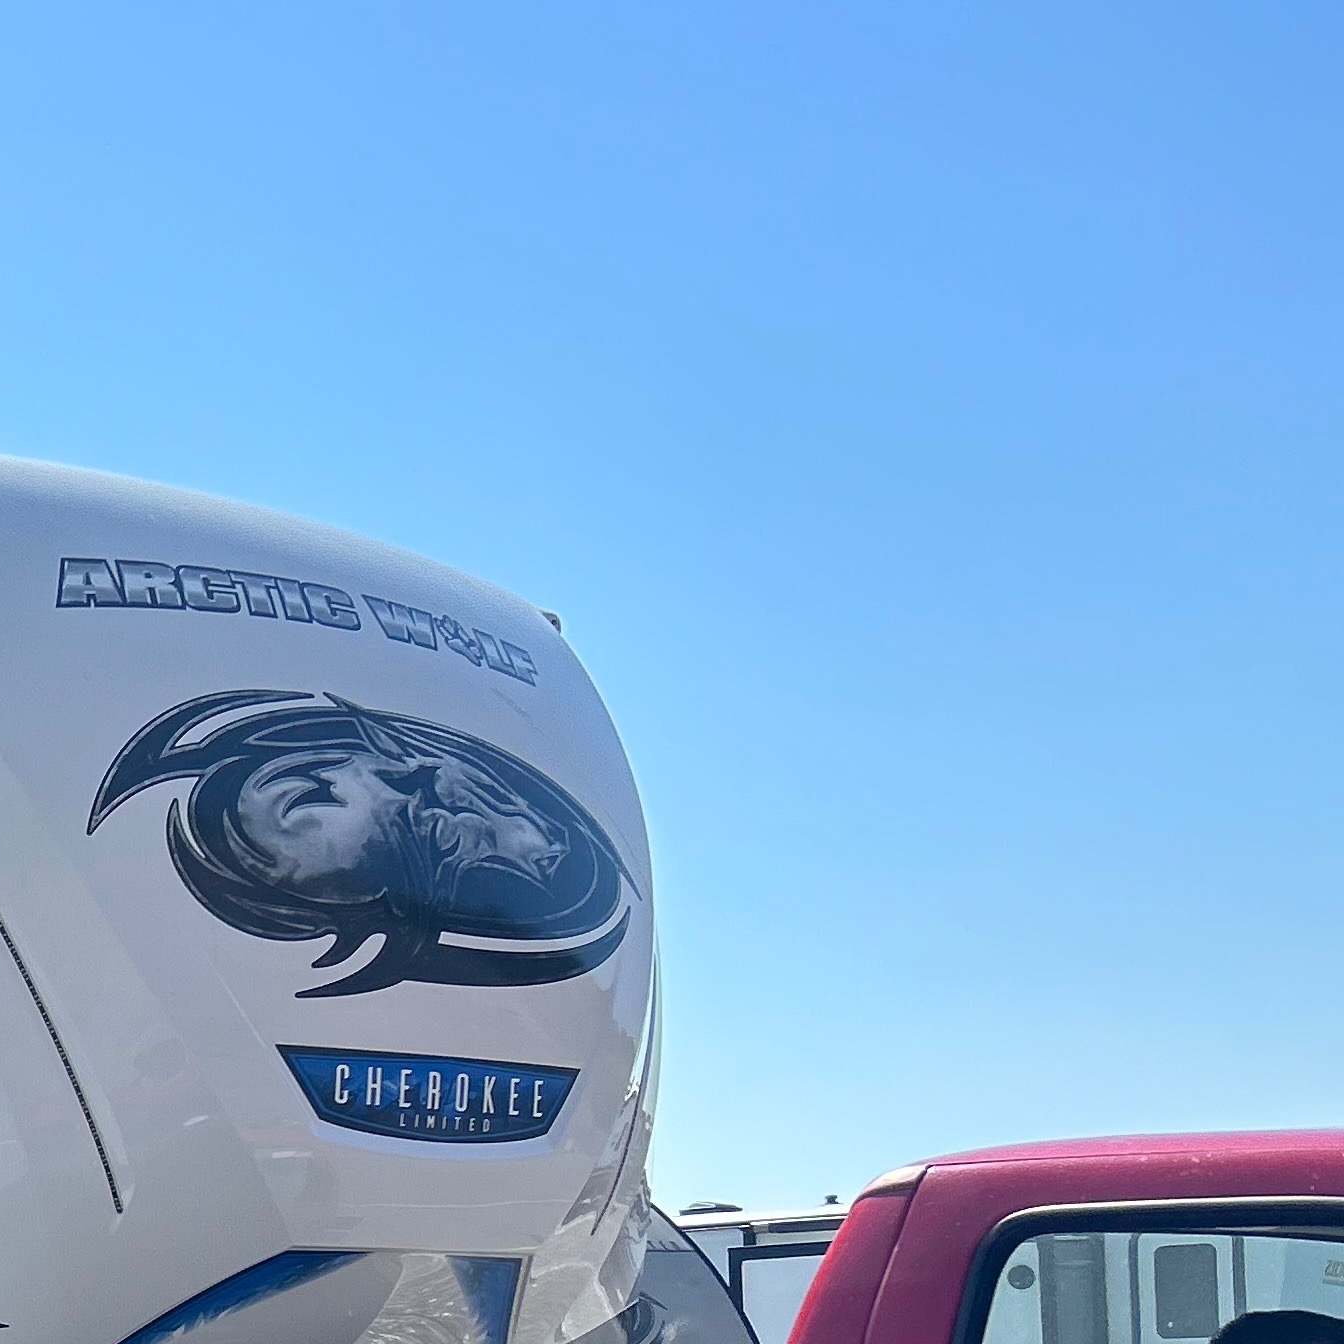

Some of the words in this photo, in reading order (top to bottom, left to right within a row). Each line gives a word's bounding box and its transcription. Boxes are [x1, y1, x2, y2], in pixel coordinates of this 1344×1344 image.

[56, 556, 361, 631] ARCTIC
[334, 1064, 544, 1118] CHEROKEE
[399, 1113, 491, 1133] LIMITED
